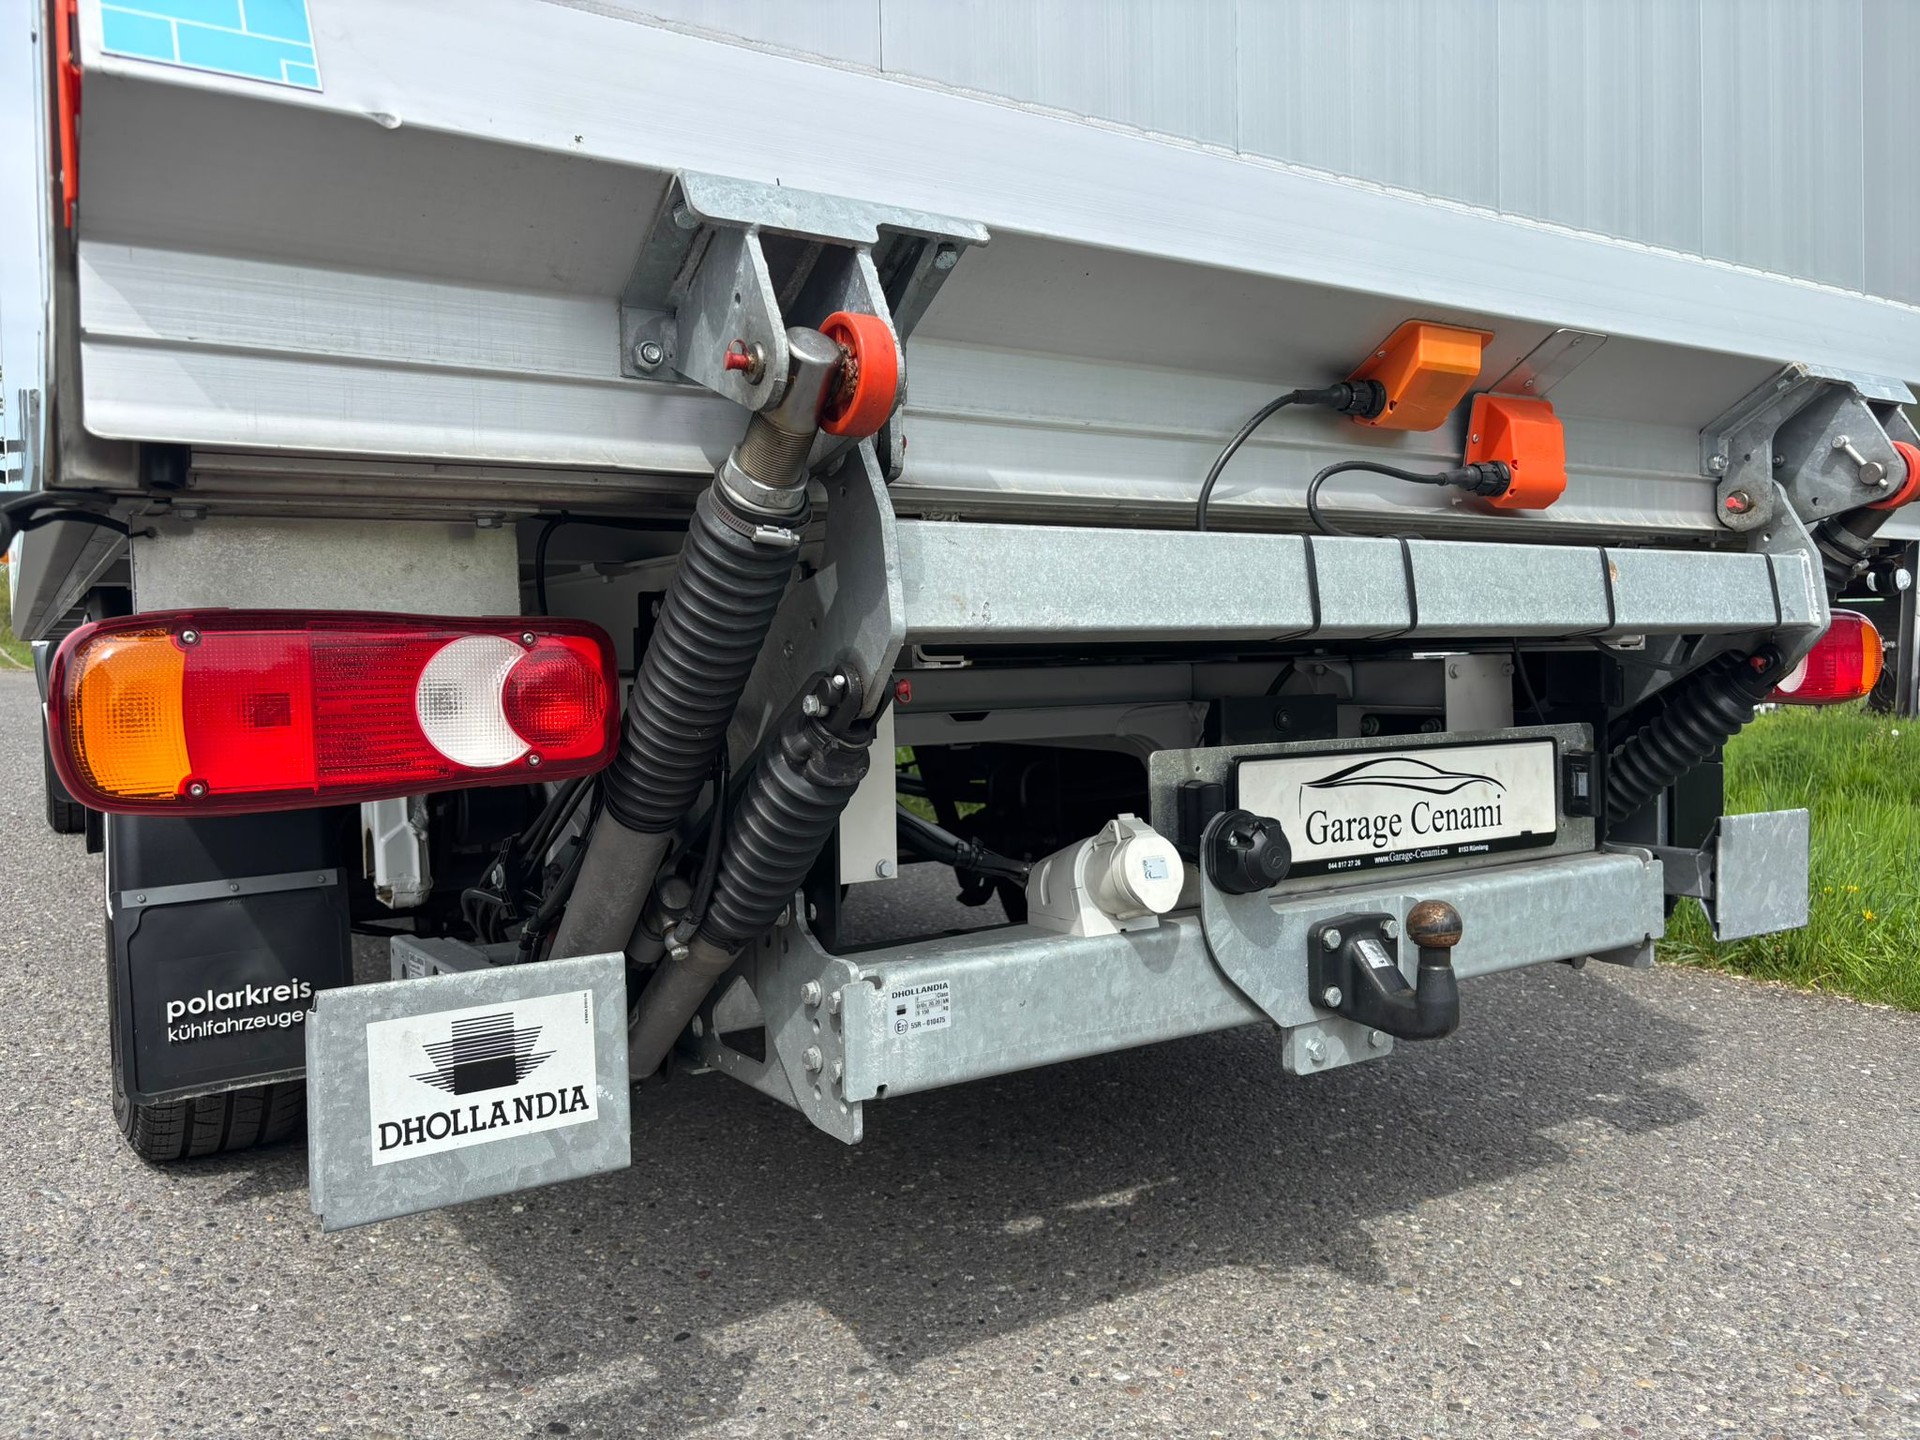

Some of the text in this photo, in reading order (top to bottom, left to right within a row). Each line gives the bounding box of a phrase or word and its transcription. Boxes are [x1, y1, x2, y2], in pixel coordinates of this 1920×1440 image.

[1305, 794, 1503, 849] Garage Cenami
[1327, 861, 1338, 870] 044
[166, 977, 312, 1024] polarkreis
[891, 981, 949, 999] DHOLLANDIA
[167, 1009, 304, 1043] kühlfahrzeuge
[378, 1084, 590, 1151] DHOLLANDIA
